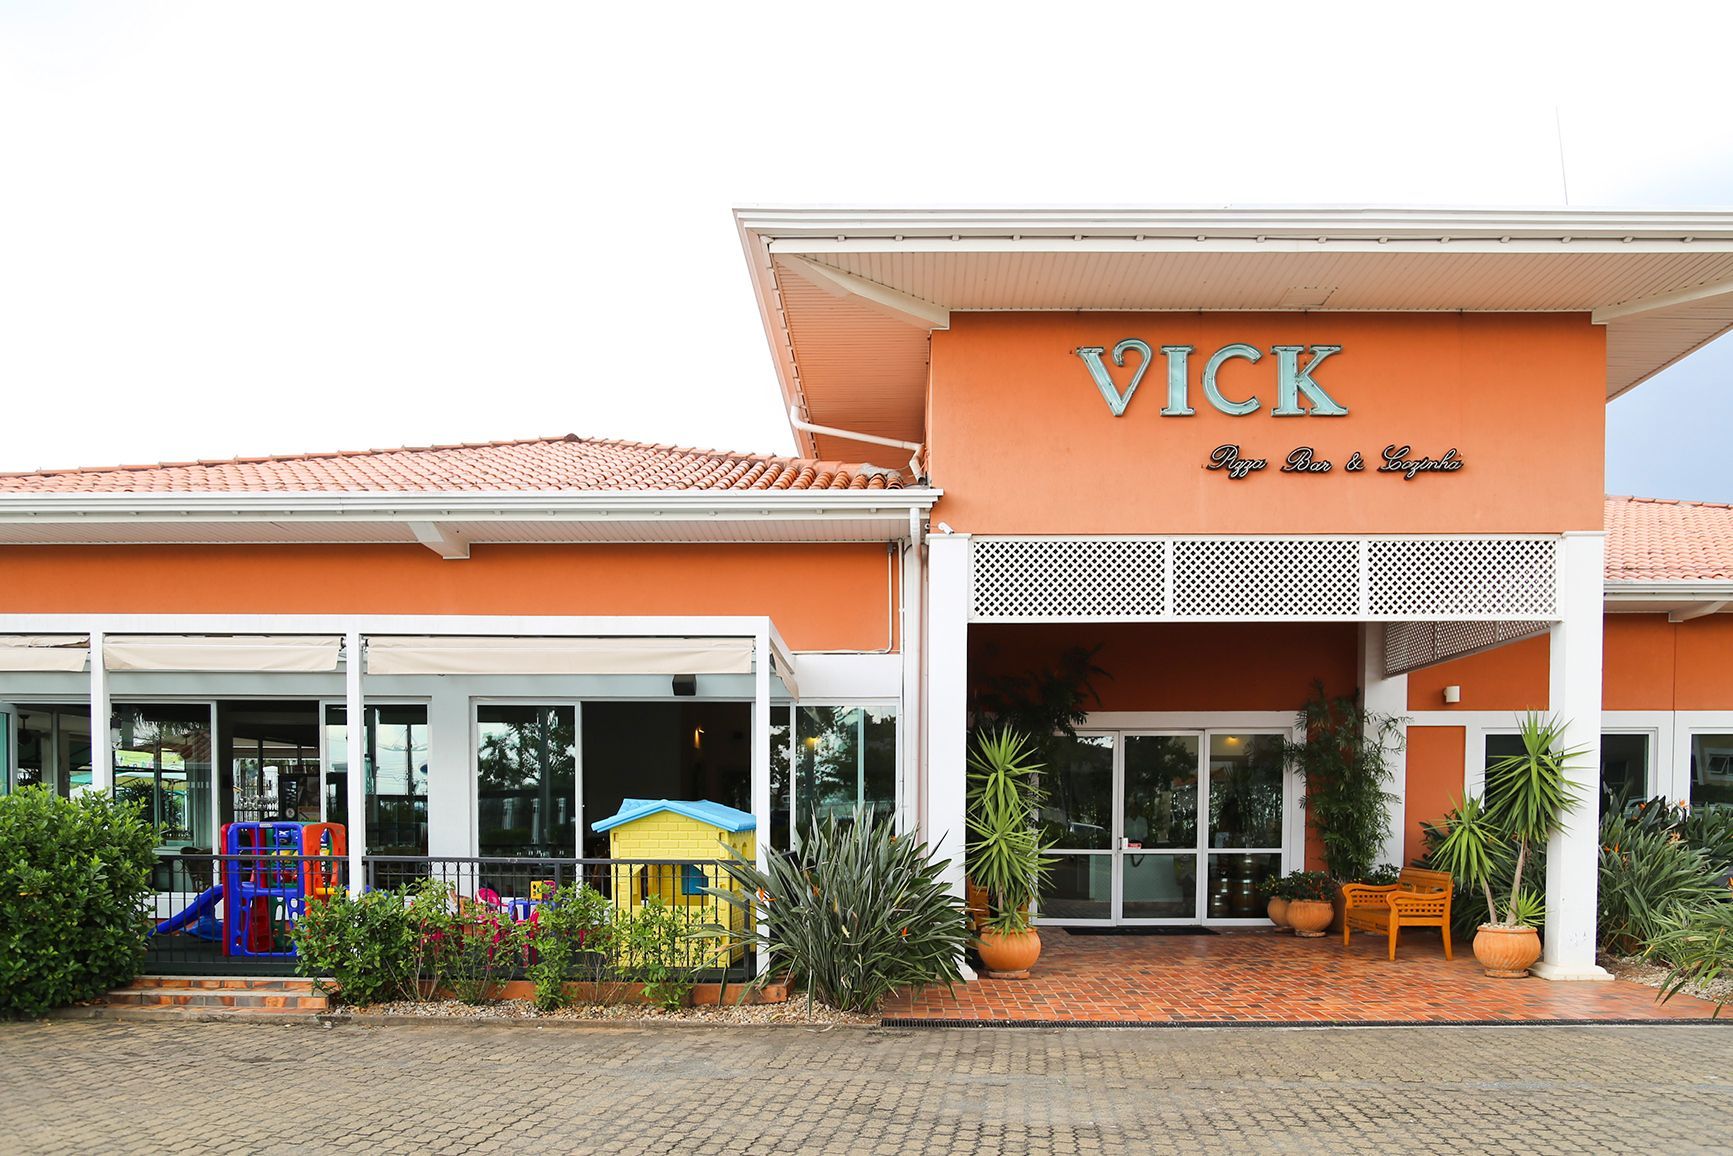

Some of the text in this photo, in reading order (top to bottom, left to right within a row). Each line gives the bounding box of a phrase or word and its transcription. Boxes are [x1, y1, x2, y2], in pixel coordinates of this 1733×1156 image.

[1076, 338, 1349, 417] VICK
[1206, 444, 1464, 480] Pizza Bar & Cozinha
